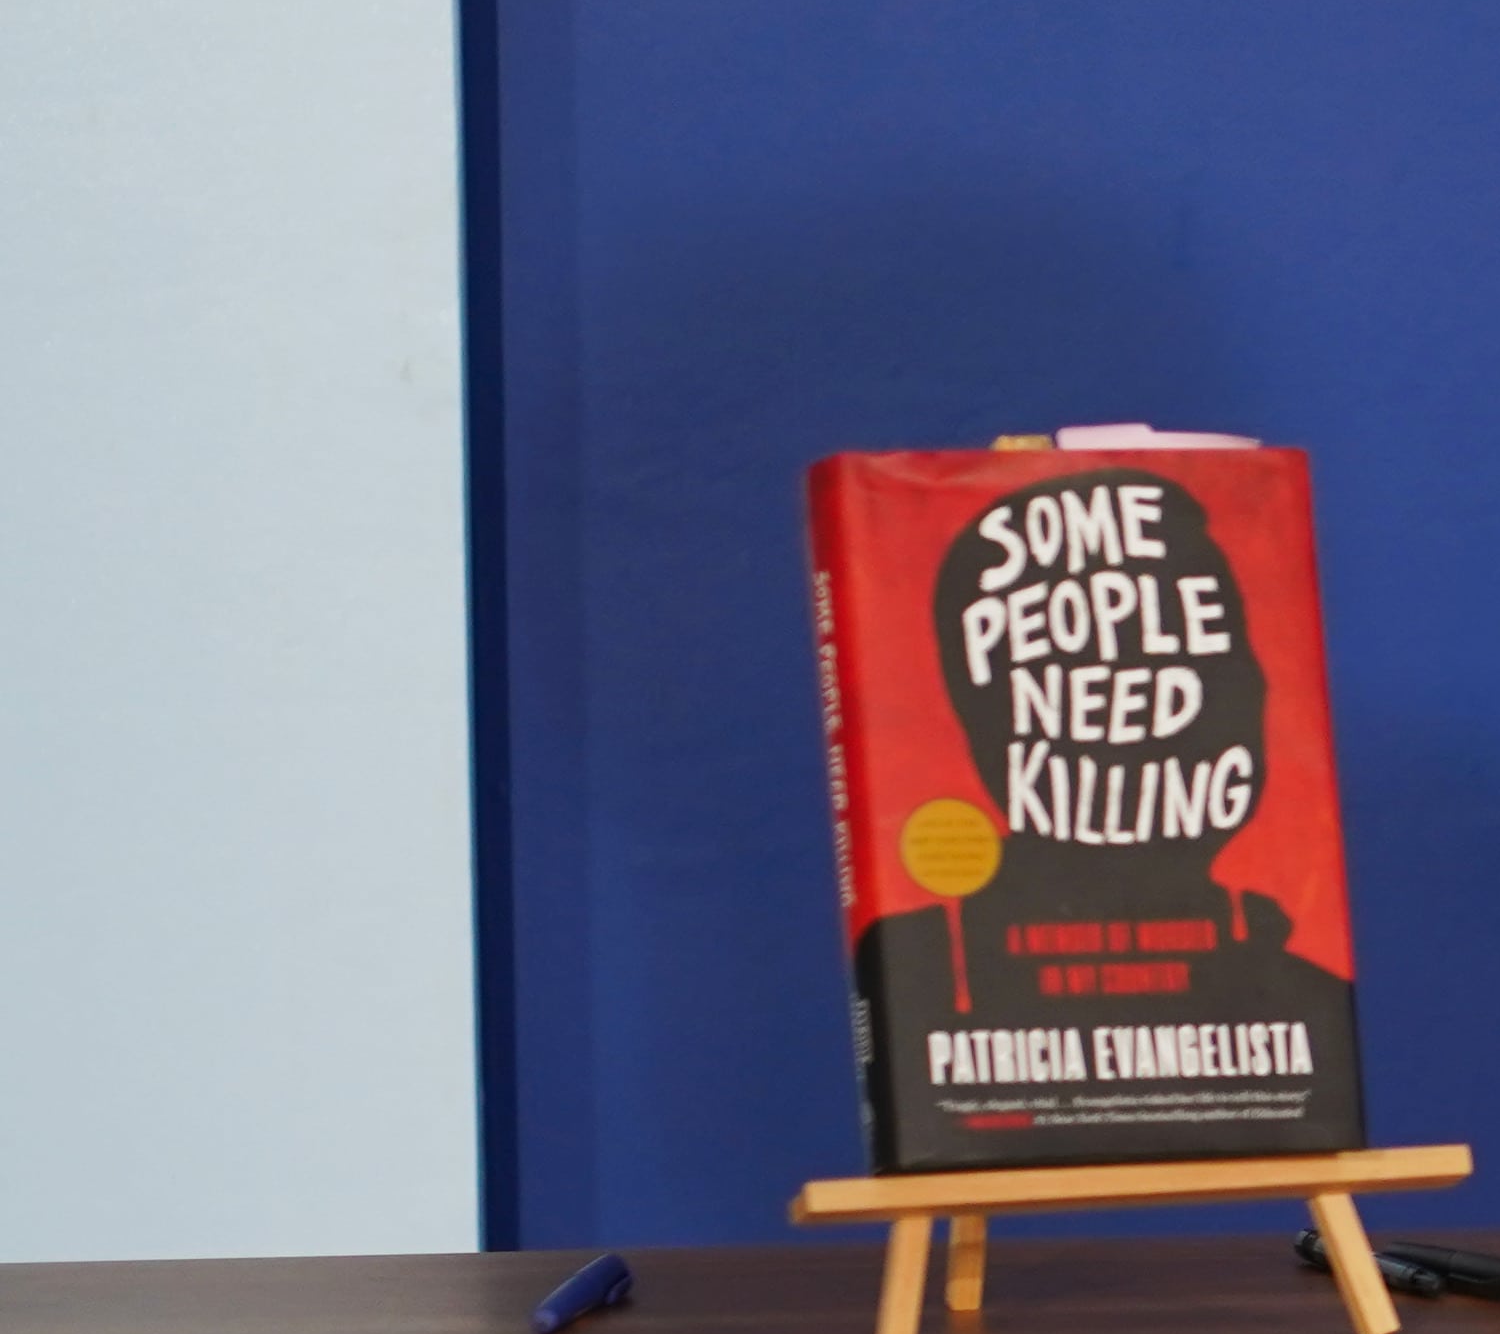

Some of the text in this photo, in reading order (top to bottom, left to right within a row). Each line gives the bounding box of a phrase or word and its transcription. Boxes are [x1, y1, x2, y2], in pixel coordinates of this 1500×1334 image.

[979, 484, 1167, 592] SOME
[961, 570, 1232, 687] PEOPLE
[1009, 664, 1203, 744] NEED
[1007, 739, 1254, 845] KILLING
[927, 1028, 1088, 1086] PATRICIA
[1091, 1021, 1314, 1081] EVANGELISTA
